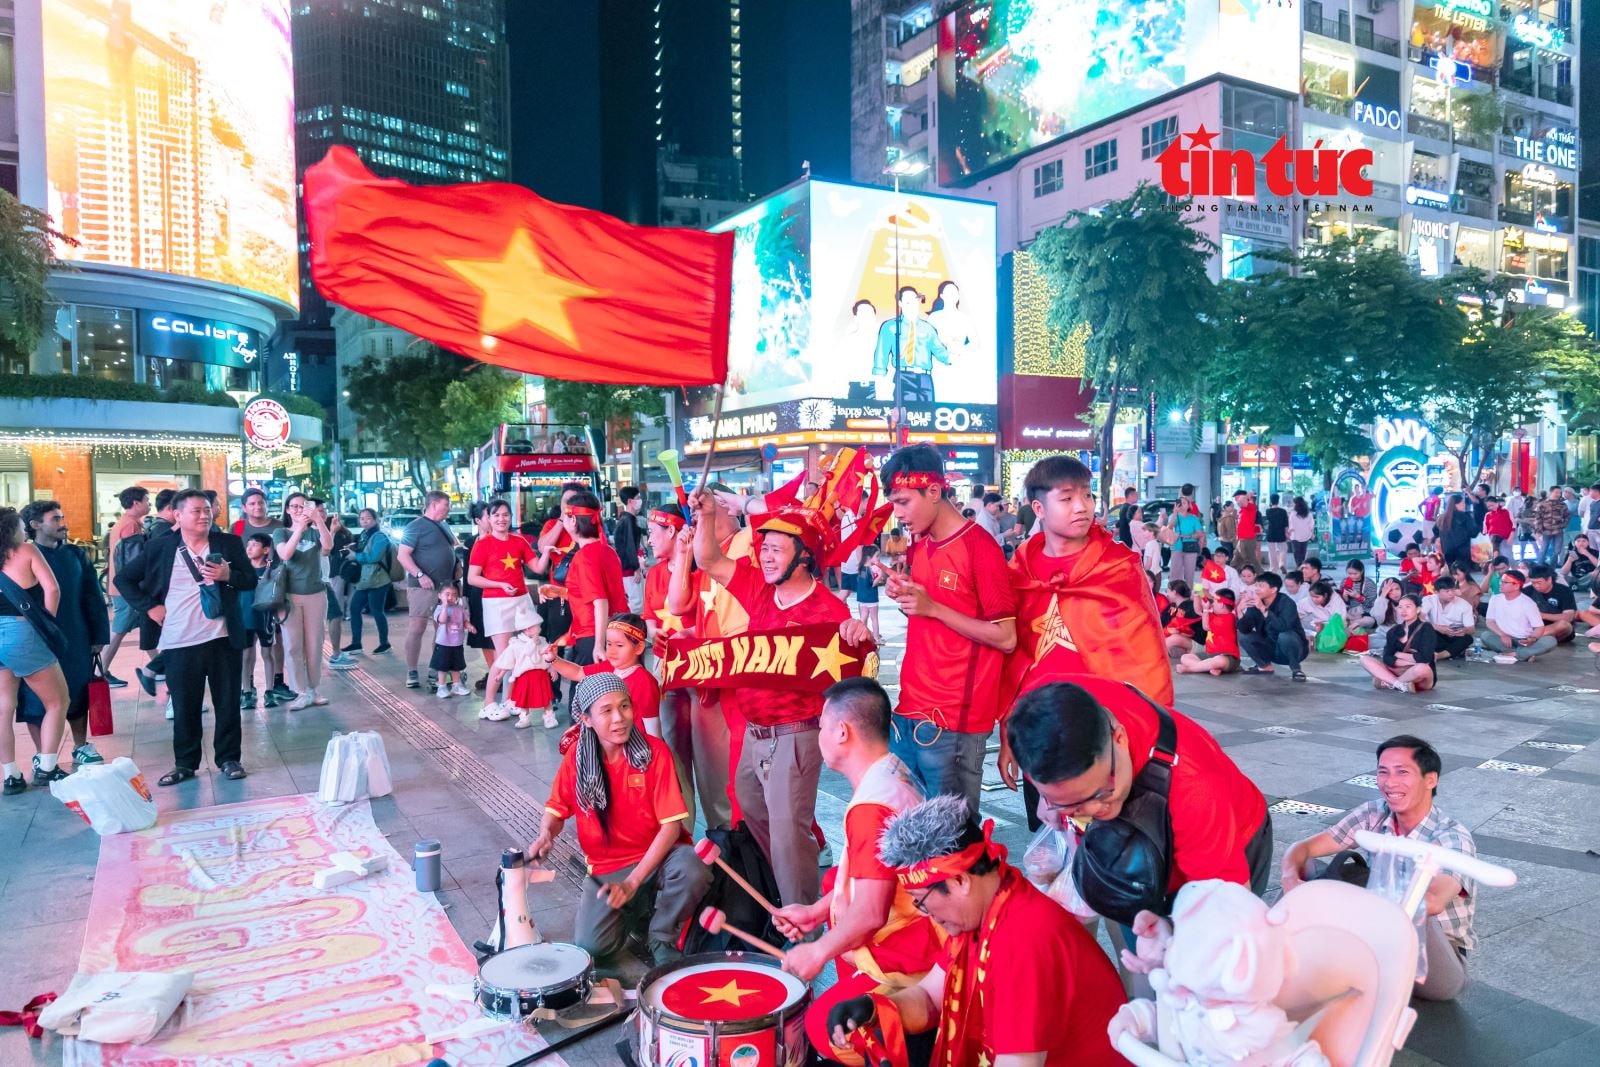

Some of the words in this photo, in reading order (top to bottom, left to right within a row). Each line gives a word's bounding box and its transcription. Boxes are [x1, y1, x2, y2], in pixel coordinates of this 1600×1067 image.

[1452, 9, 1487, 32] LETTER
[1354, 101, 1401, 130] FADO
[1513, 135, 1543, 161] THE
[1547, 145, 1576, 169] ONE
[289, 360, 297, 391] HOTEL
[834, 406, 862, 418] Happy
[863, 406, 881, 416] New
[907, 411, 932, 421] SALE
[1376, 417, 1428, 451] OXY
[729, 636, 805, 676] NAM
